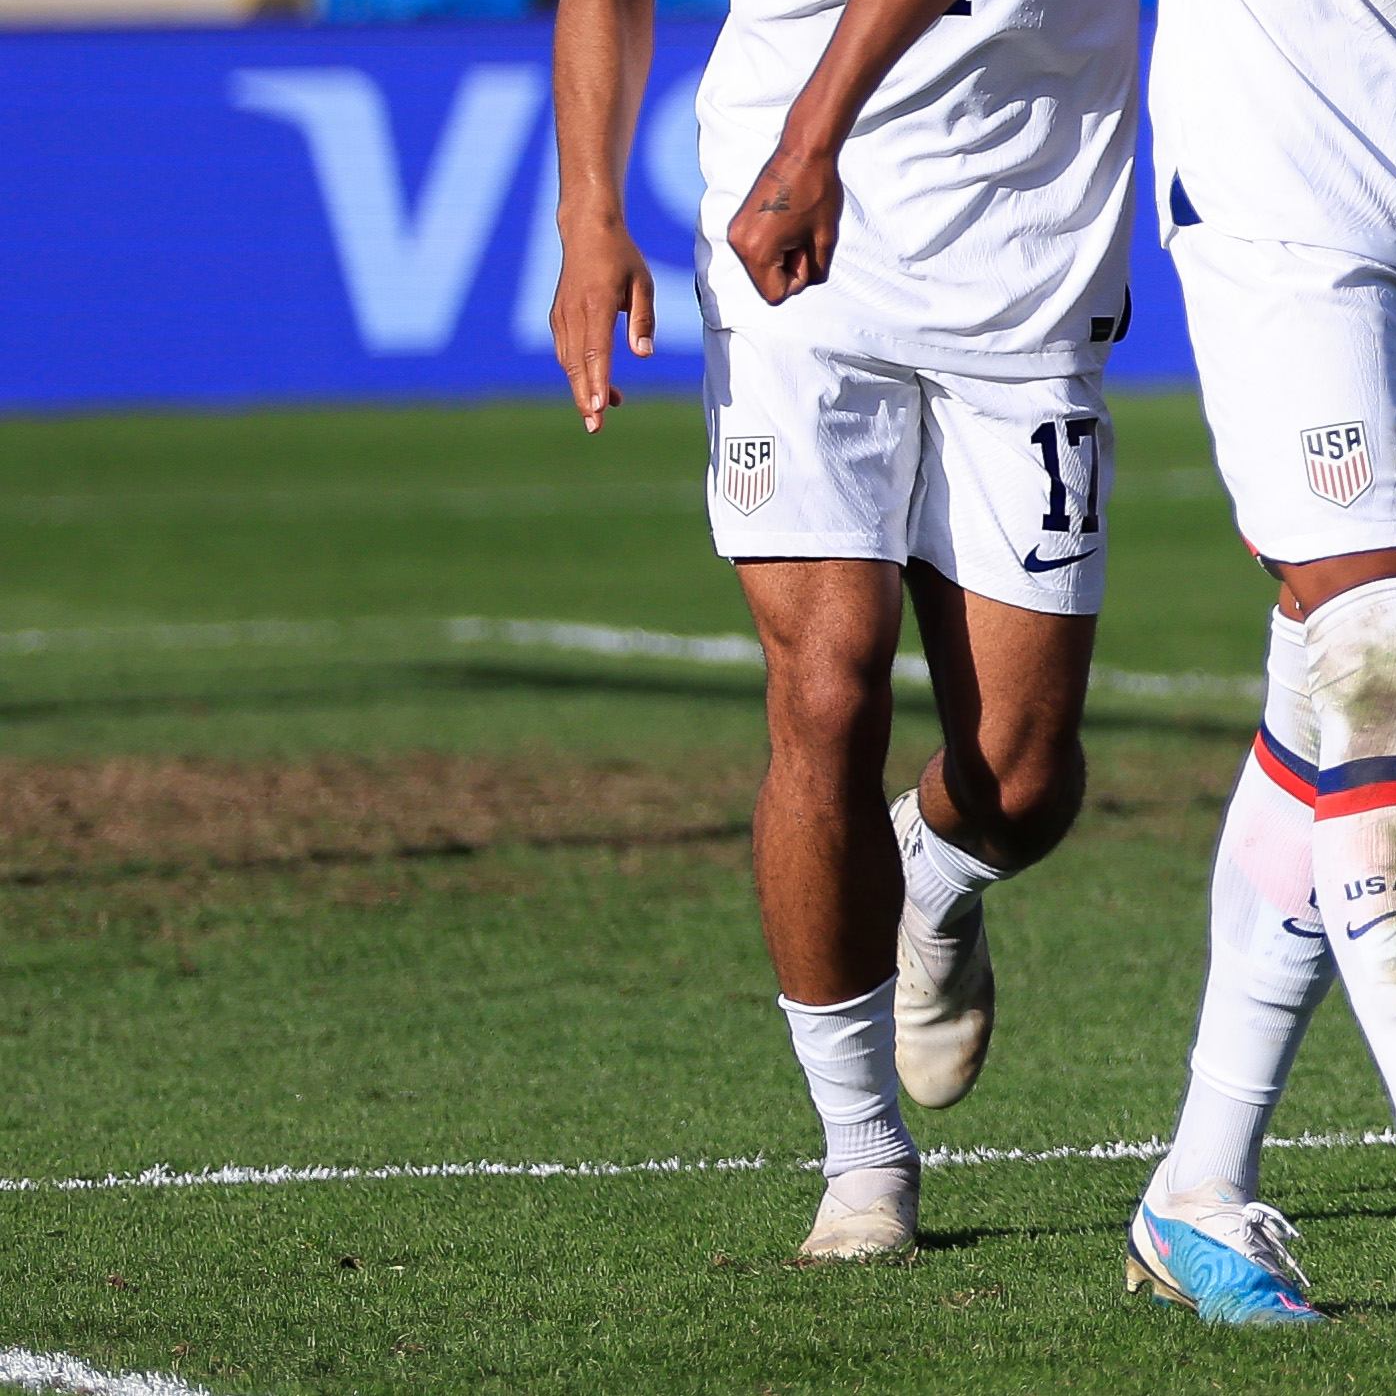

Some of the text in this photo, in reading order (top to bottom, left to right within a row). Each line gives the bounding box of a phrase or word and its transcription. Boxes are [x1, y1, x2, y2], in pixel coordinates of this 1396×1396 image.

[729, 442, 771, 470] USA
[1306, 427, 1361, 460] USA
[1031, 417, 1099, 534] 17
